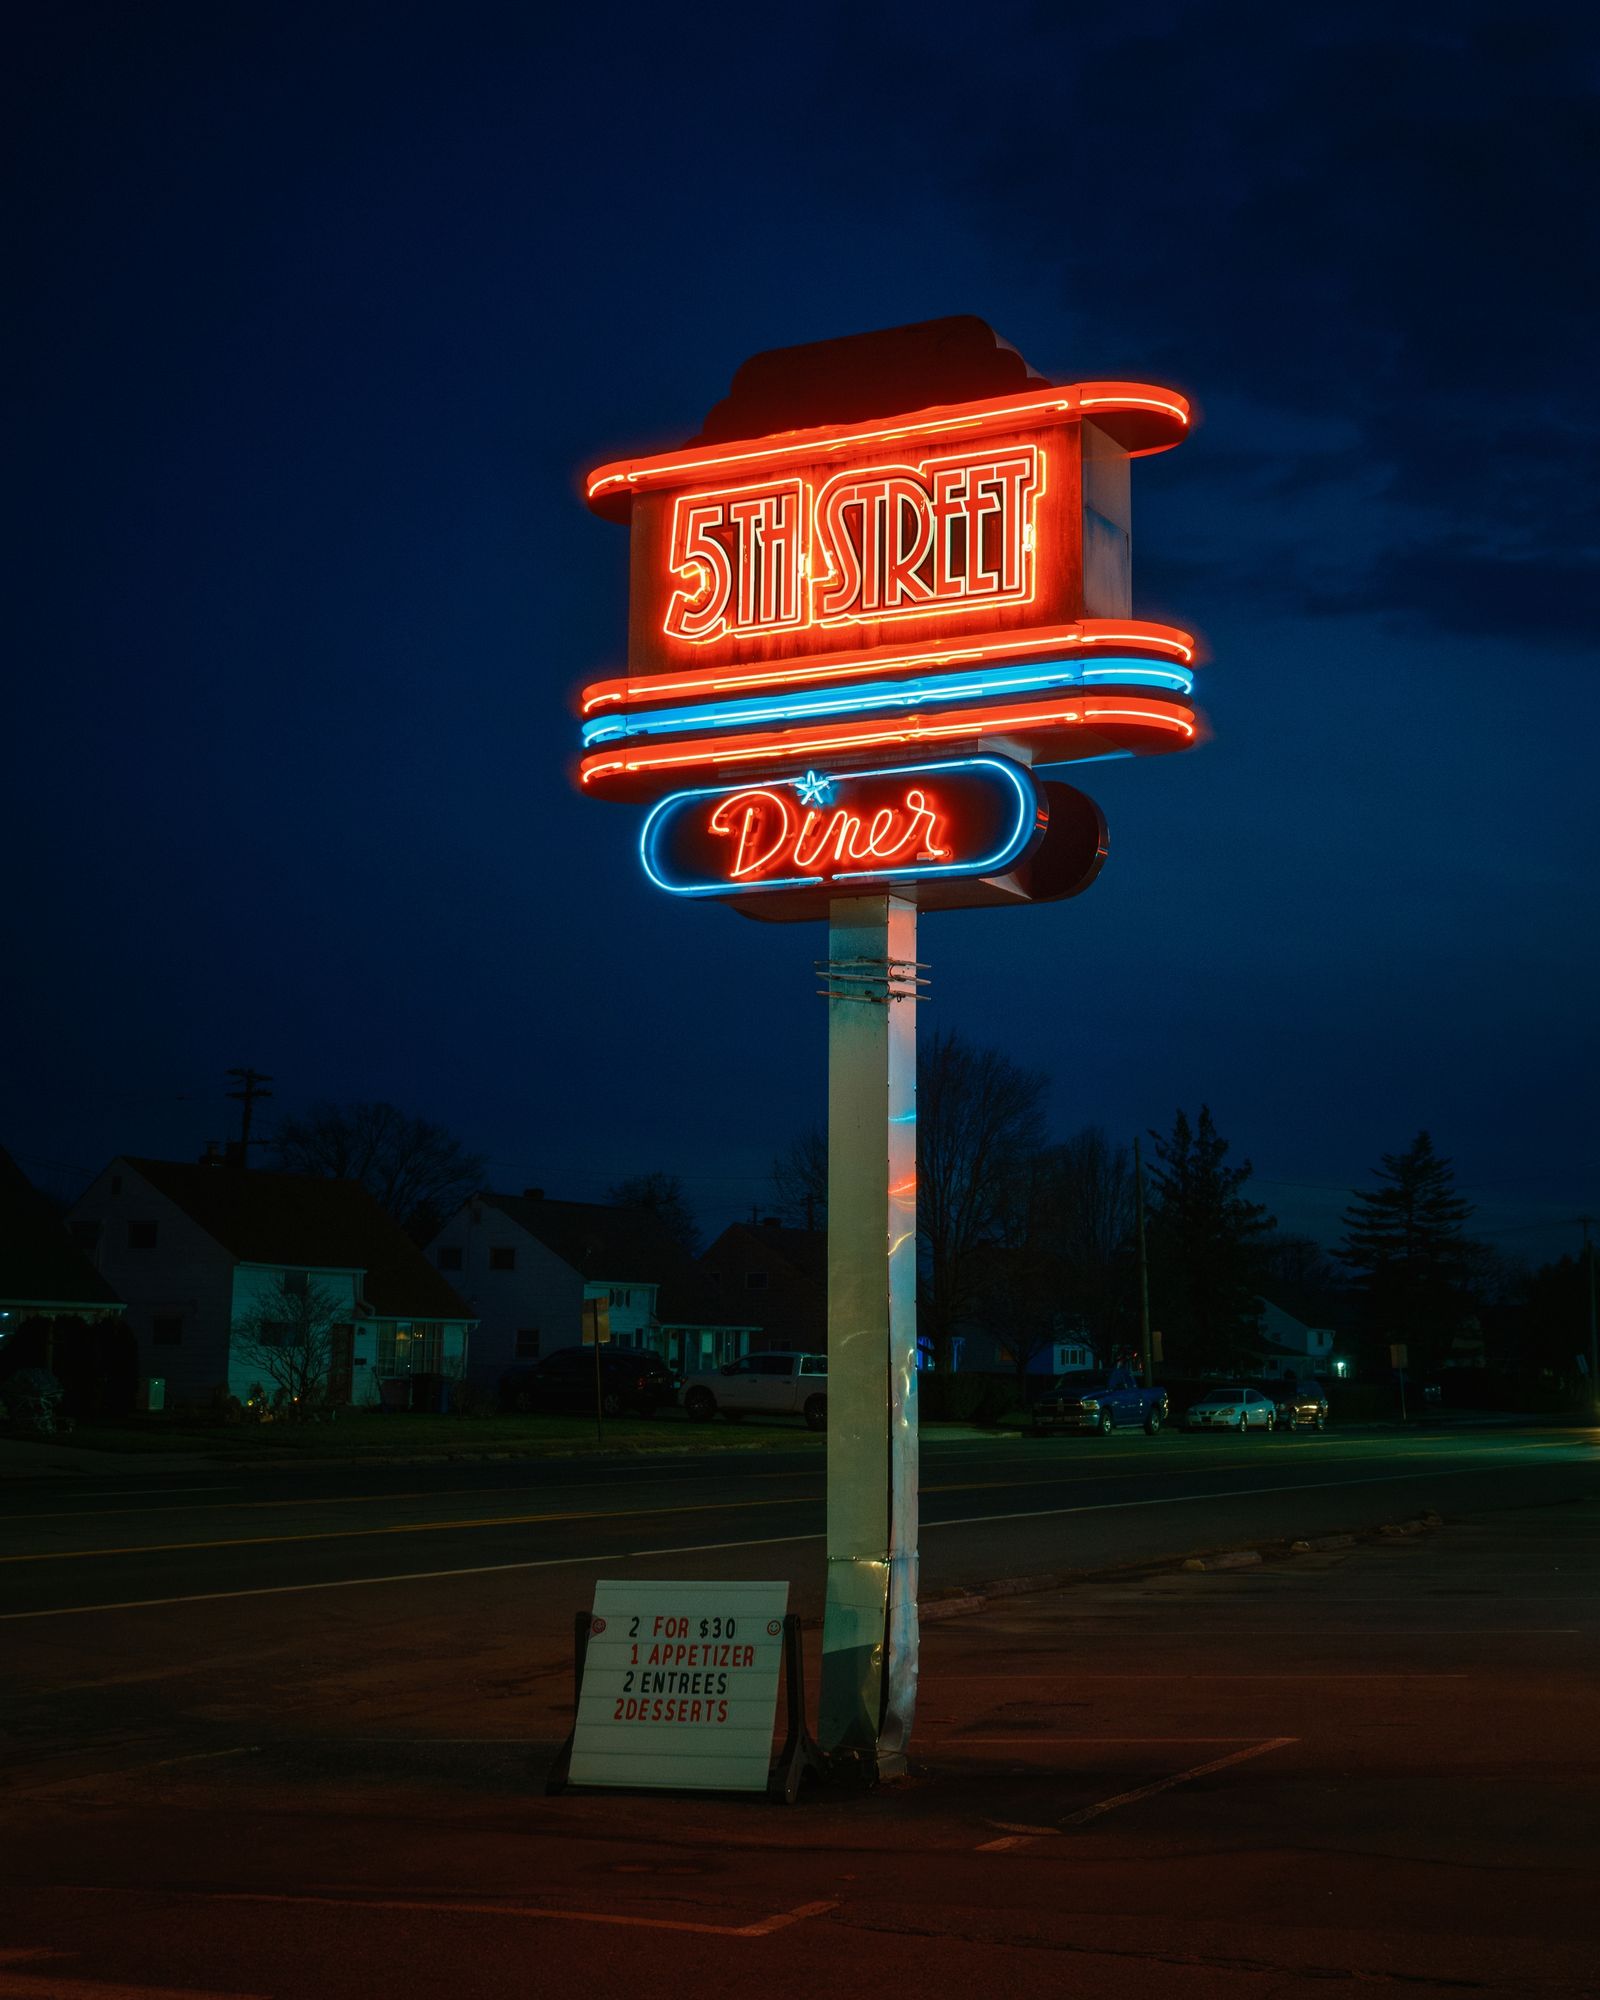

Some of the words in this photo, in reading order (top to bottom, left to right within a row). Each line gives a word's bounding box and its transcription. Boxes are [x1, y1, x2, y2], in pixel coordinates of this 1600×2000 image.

[679, 492, 799, 633] 5TH
[823, 457, 1032, 614] STREET
[711, 789, 945, 878] Diner
[629, 1616, 640, 1637] 2
[653, 1616, 689, 1638] FOR
[699, 1617, 735, 1639] $30
[631, 1643, 639, 1665] 1
[648, 1644, 754, 1667] APPETIZER
[623, 1671, 634, 1692] 2
[641, 1672, 727, 1694] ENTREES
